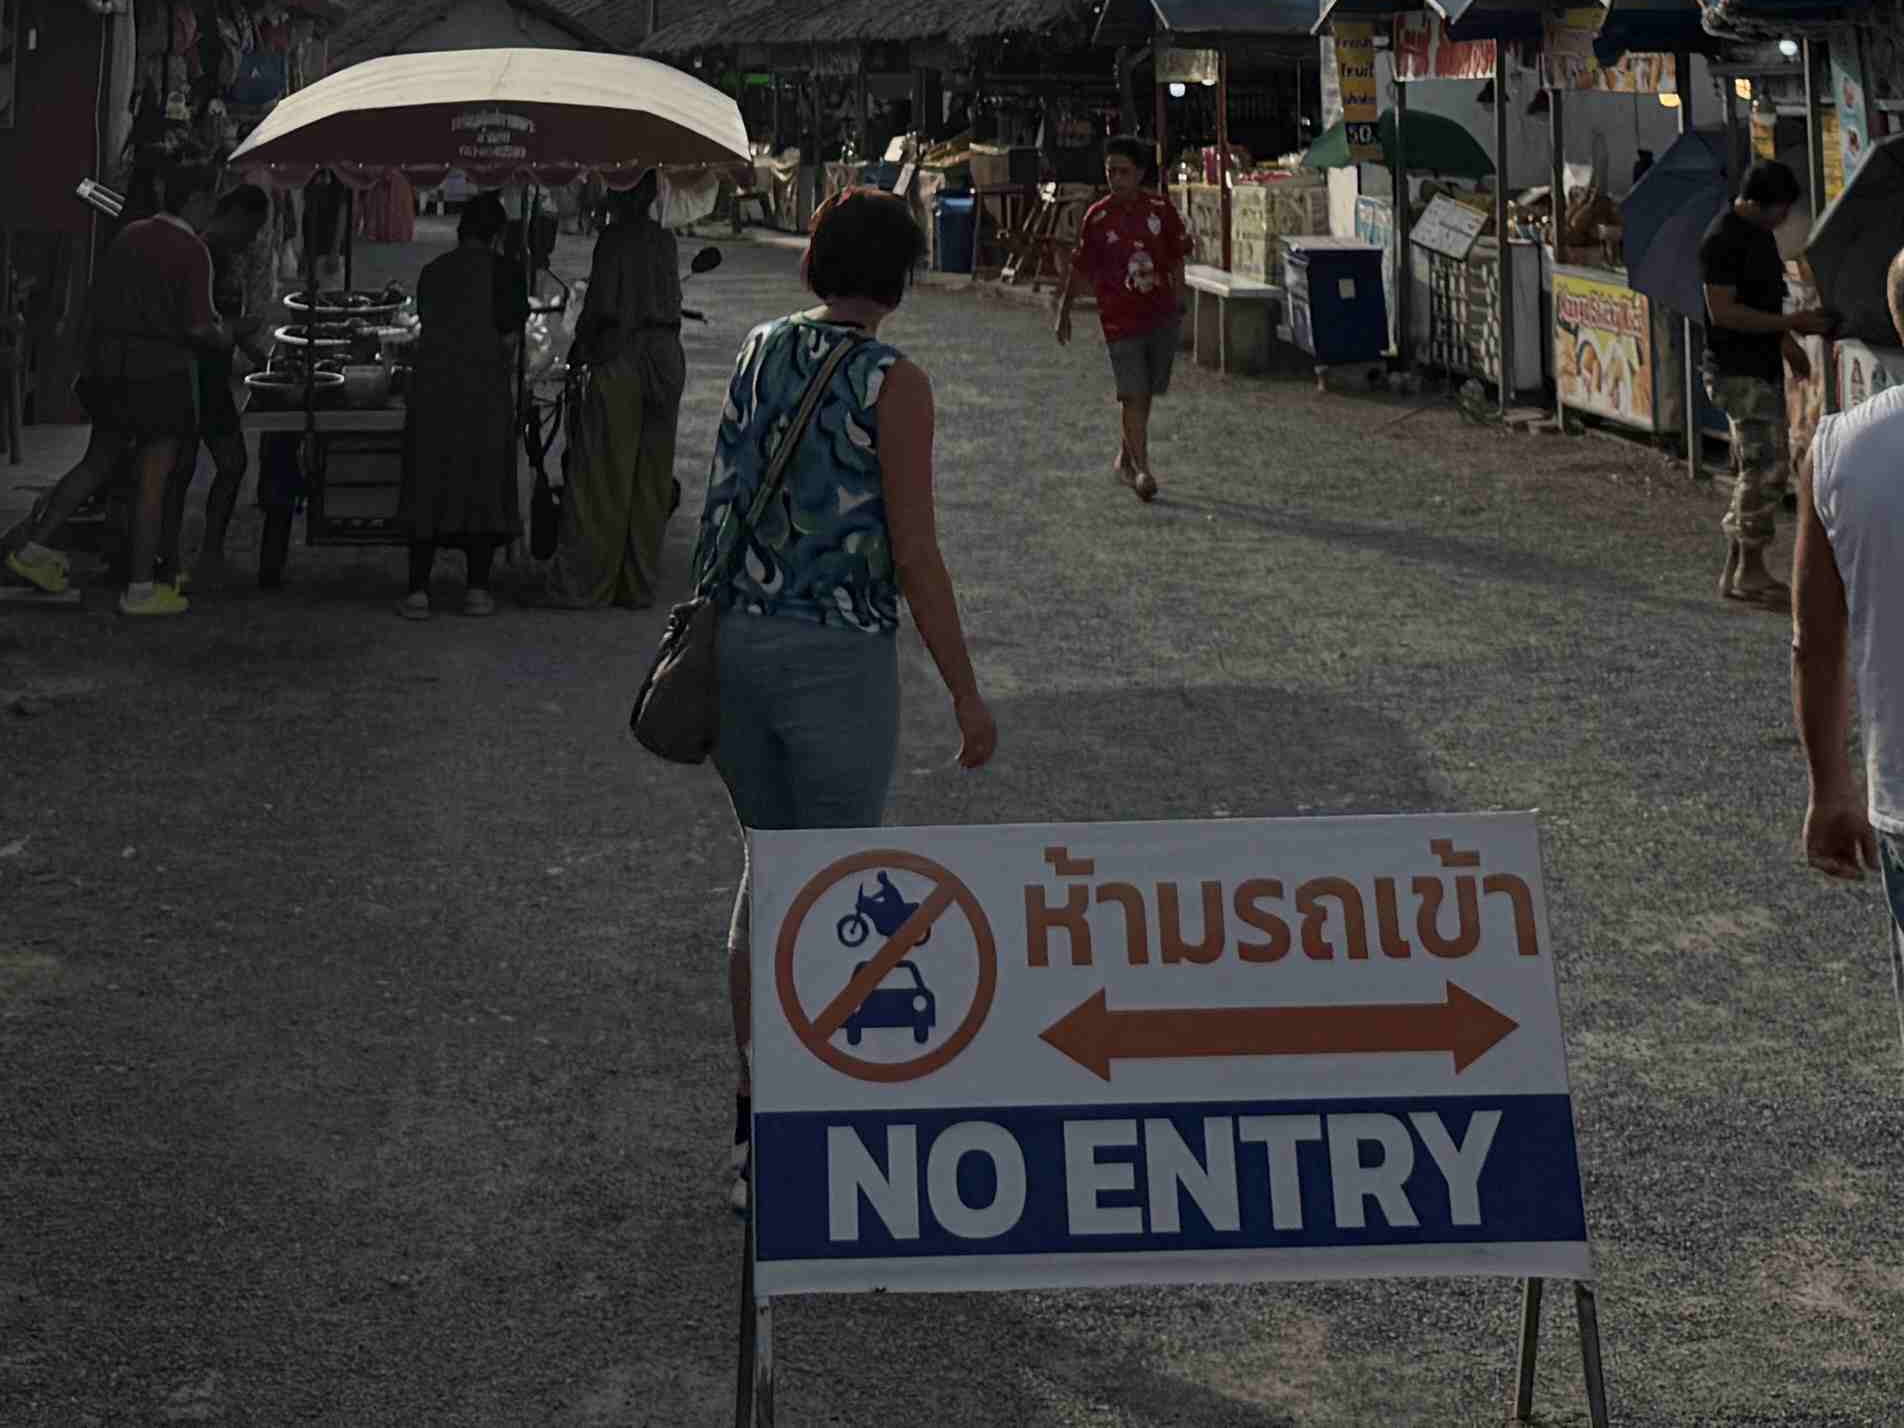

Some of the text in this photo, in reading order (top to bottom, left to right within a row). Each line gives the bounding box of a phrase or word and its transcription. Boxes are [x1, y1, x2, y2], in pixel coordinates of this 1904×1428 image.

[1023, 838, 1540, 968] ห้ามรถเข้า
[826, 1109, 1503, 1243] NO ENTRY
